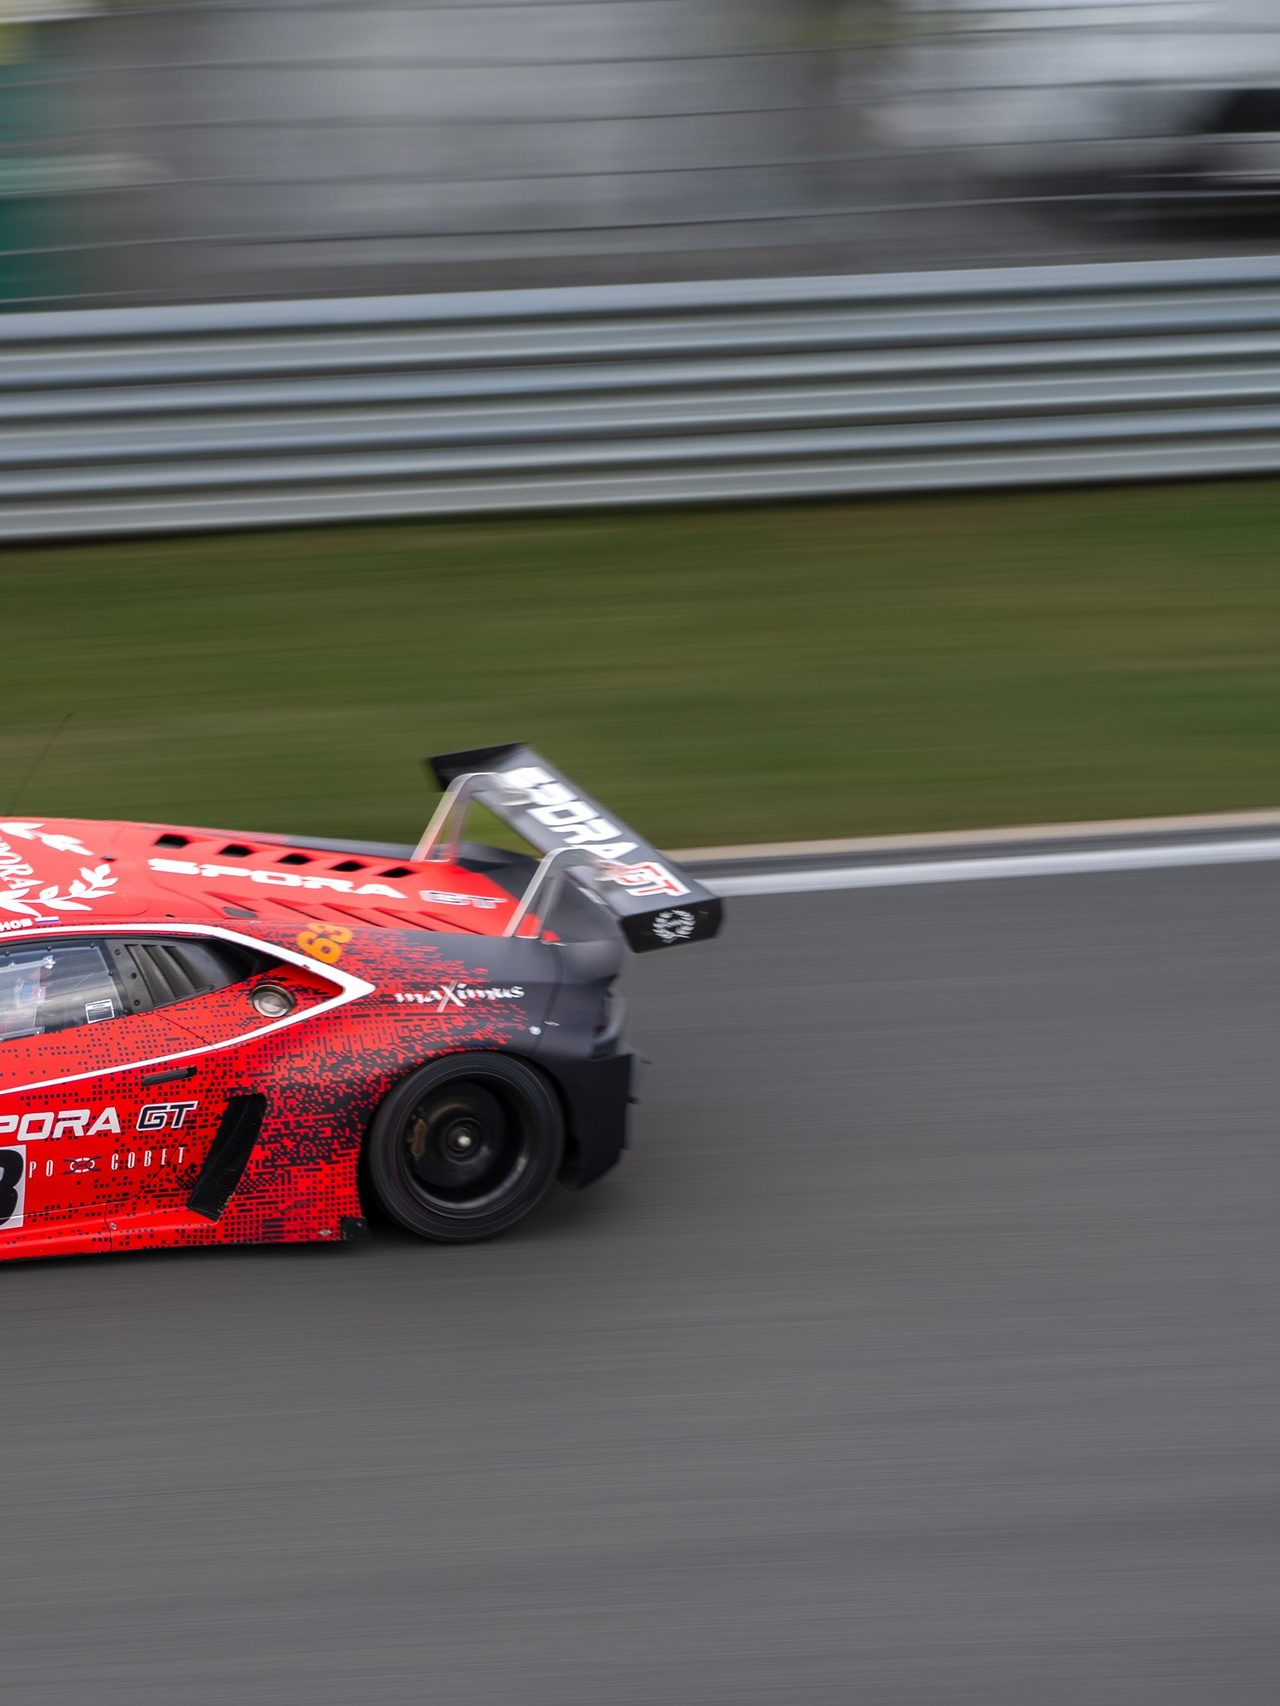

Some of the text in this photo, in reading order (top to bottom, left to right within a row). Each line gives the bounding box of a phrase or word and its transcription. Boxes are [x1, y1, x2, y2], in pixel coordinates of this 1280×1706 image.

[148, 858, 408, 899] SPORA
[296, 922, 354, 965] 63
[136, 1101, 199, 1132] GT
